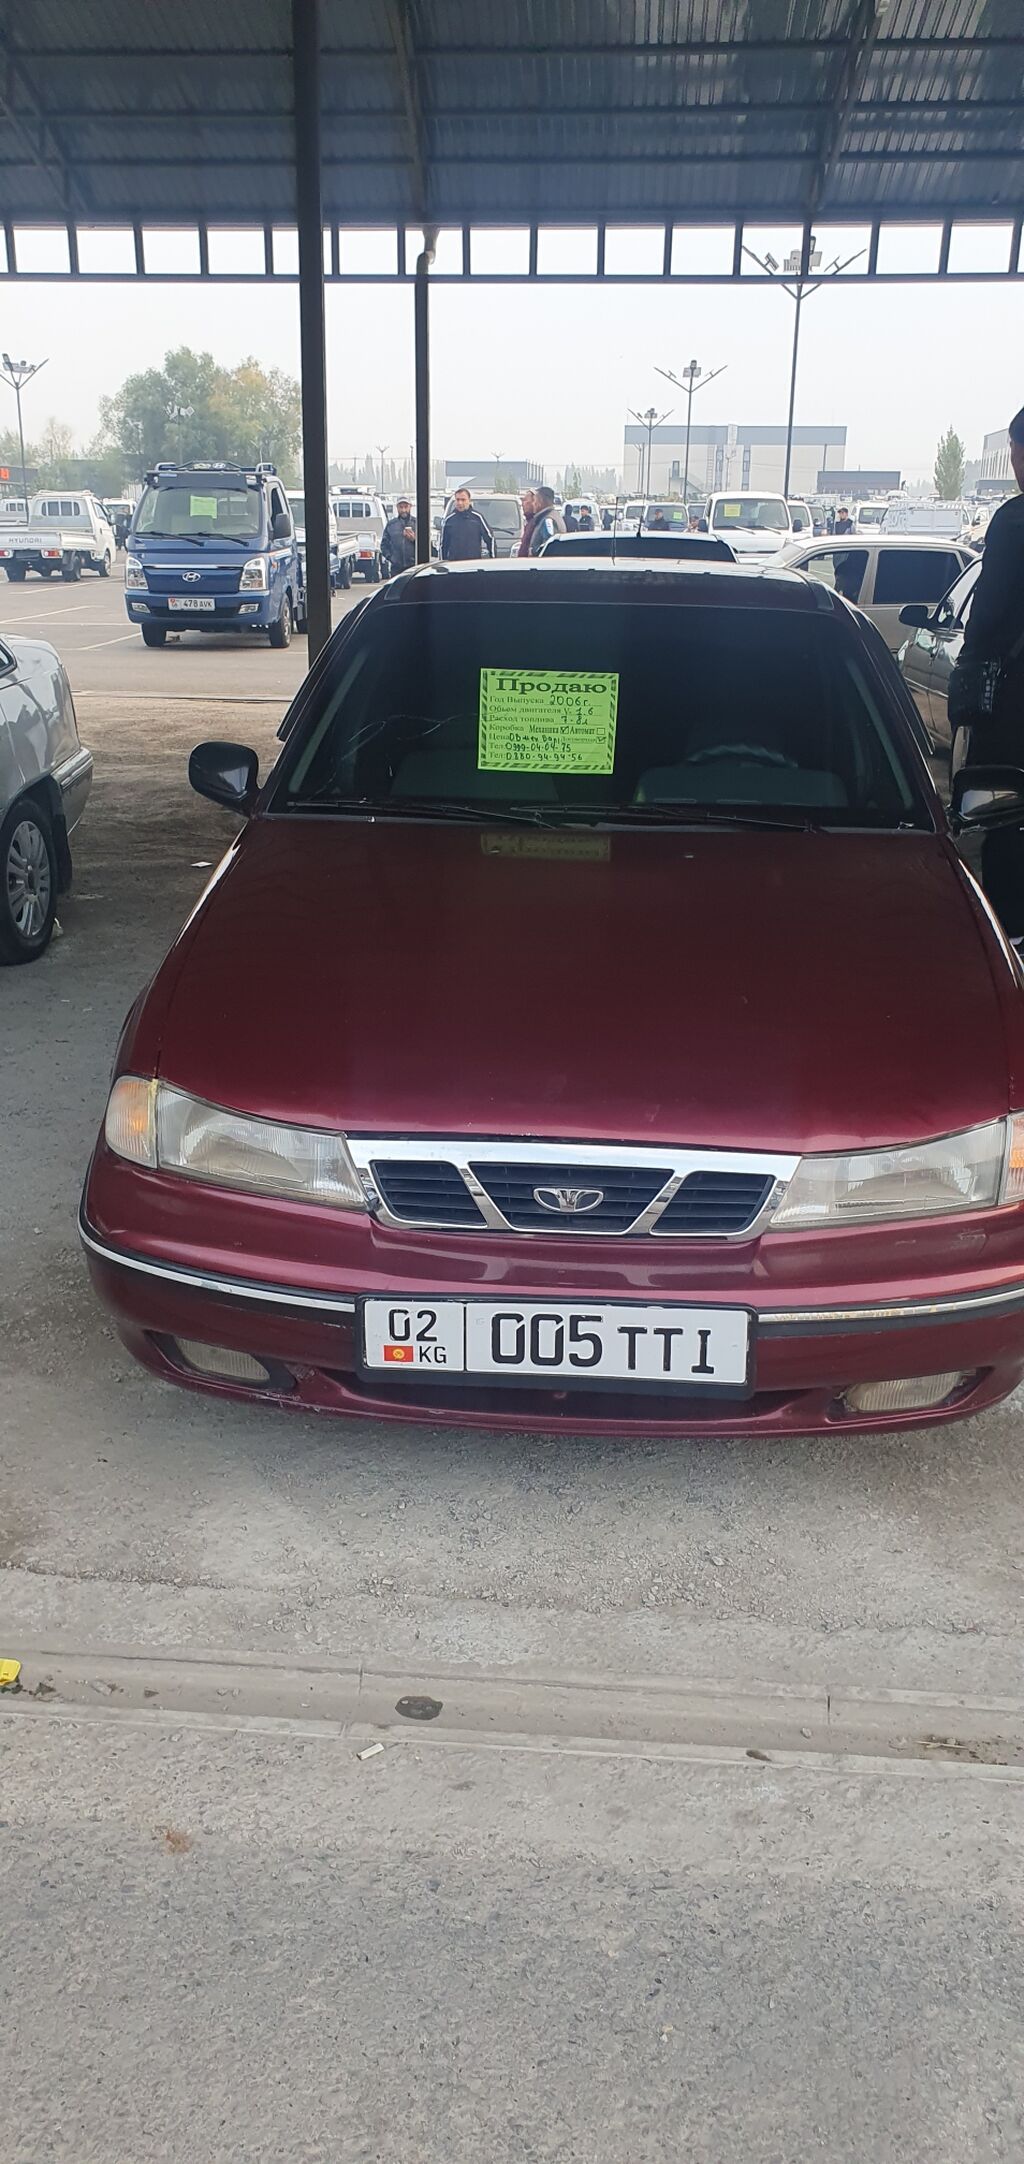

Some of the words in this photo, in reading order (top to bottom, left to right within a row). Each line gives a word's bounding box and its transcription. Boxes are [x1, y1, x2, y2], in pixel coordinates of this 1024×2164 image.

[183, 599, 198, 607] 478
[496, 677, 607, 695] Продаю
[489, 695, 506, 703] Год
[489, 714, 517, 722] Расход
[489, 724, 524, 733] Коробка
[570, 727, 595, 735] Автомат
[388, 1308, 438, 1342] 02
[491, 1312, 603, 1368] 005
[616, 1325, 716, 1375] TTI
[418, 1345, 447, 1364] KG
